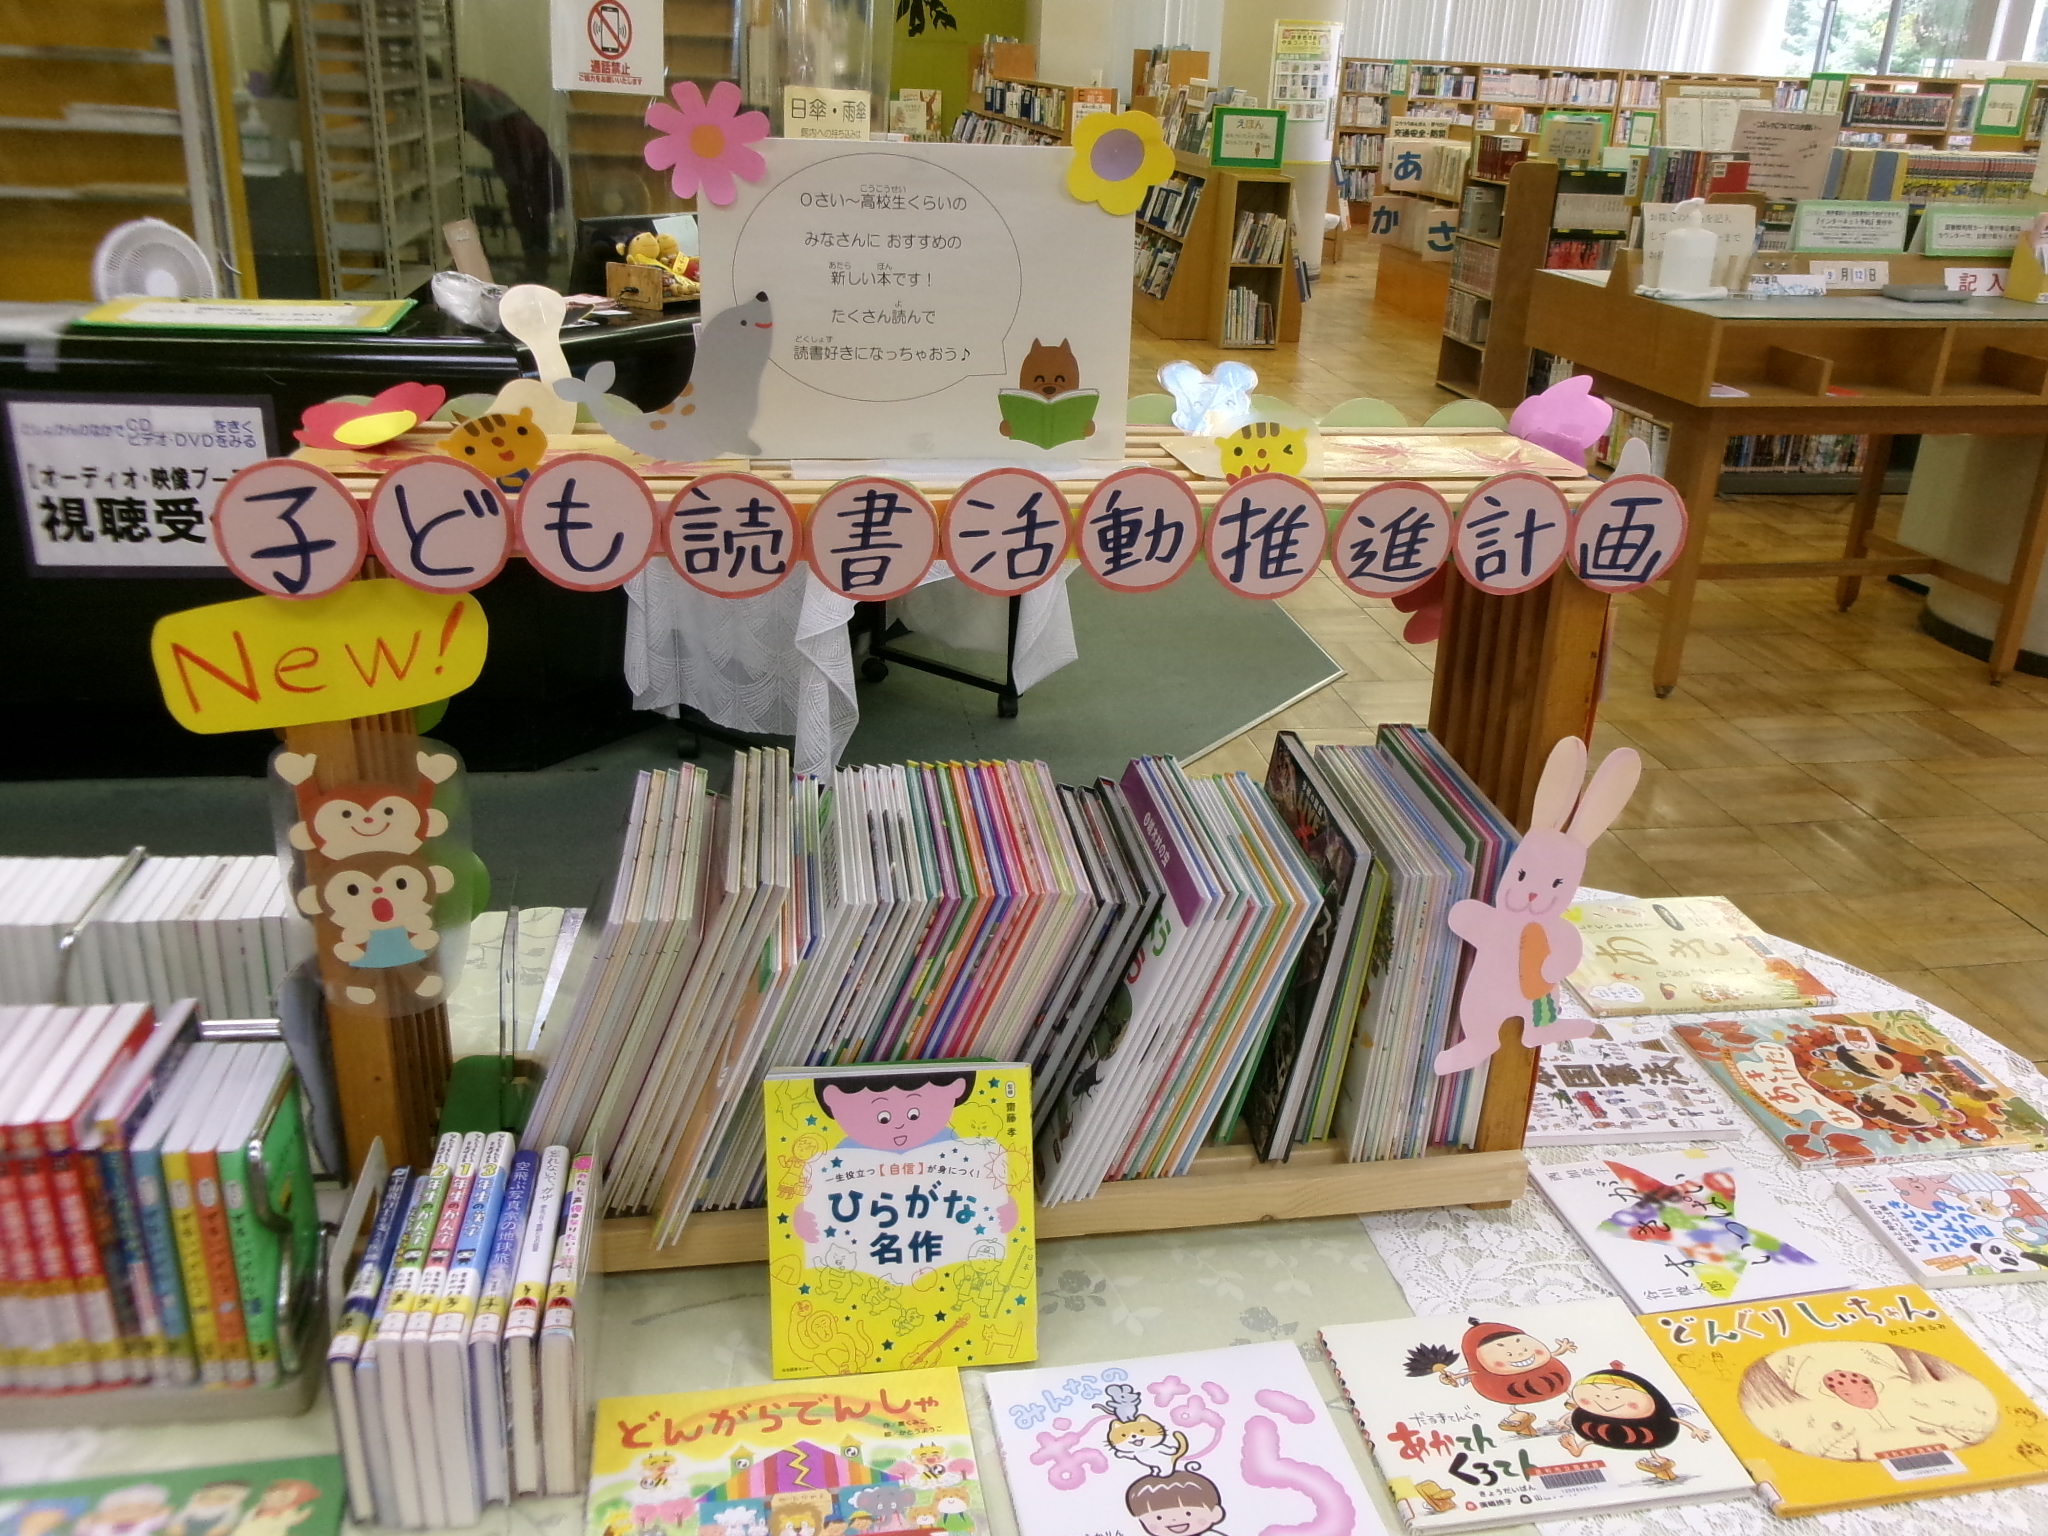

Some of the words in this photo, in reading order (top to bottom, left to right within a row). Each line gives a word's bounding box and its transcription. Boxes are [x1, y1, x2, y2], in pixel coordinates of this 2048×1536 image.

[591, 60, 631, 76] 通話禁止
[791, 98, 867, 122] 日傘・雨傘
[1394, 151, 1423, 181] あ
[1371, 205, 1399, 235] か
[1427, 220, 1457, 252] さ
[804, 231, 881, 249] みなさんに
[886, 233, 963, 250] おすすめの
[828, 261, 851, 270] あたら
[876, 262, 893, 271] ほん
[831, 271, 933, 288] 新しい本です！
[1958, 272, 2005, 293] 記入
[831, 309, 937, 326] たくさん読んで
[125, 418, 151, 432] CD
[214, 419, 252, 434] をきく
[38, 495, 214, 543] 視聴受
[243, 478, 1665, 595] 子ども読書活動推進計画
[170, 601, 465, 713] New!
[827, 1180, 978, 1229] ひらがな
[869, 1229, 944, 1266] 名作
[1658, 1306, 1790, 1346] どんぐり
[1795, 1294, 1938, 1330] しいちゃん
[1008, 1367, 1129, 1430] みんなの
[616, 1388, 939, 1450] どんがらでんしゃ
[1387, 1421, 1498, 1464] あかてん
[1448, 1448, 1540, 1487] くろてん
